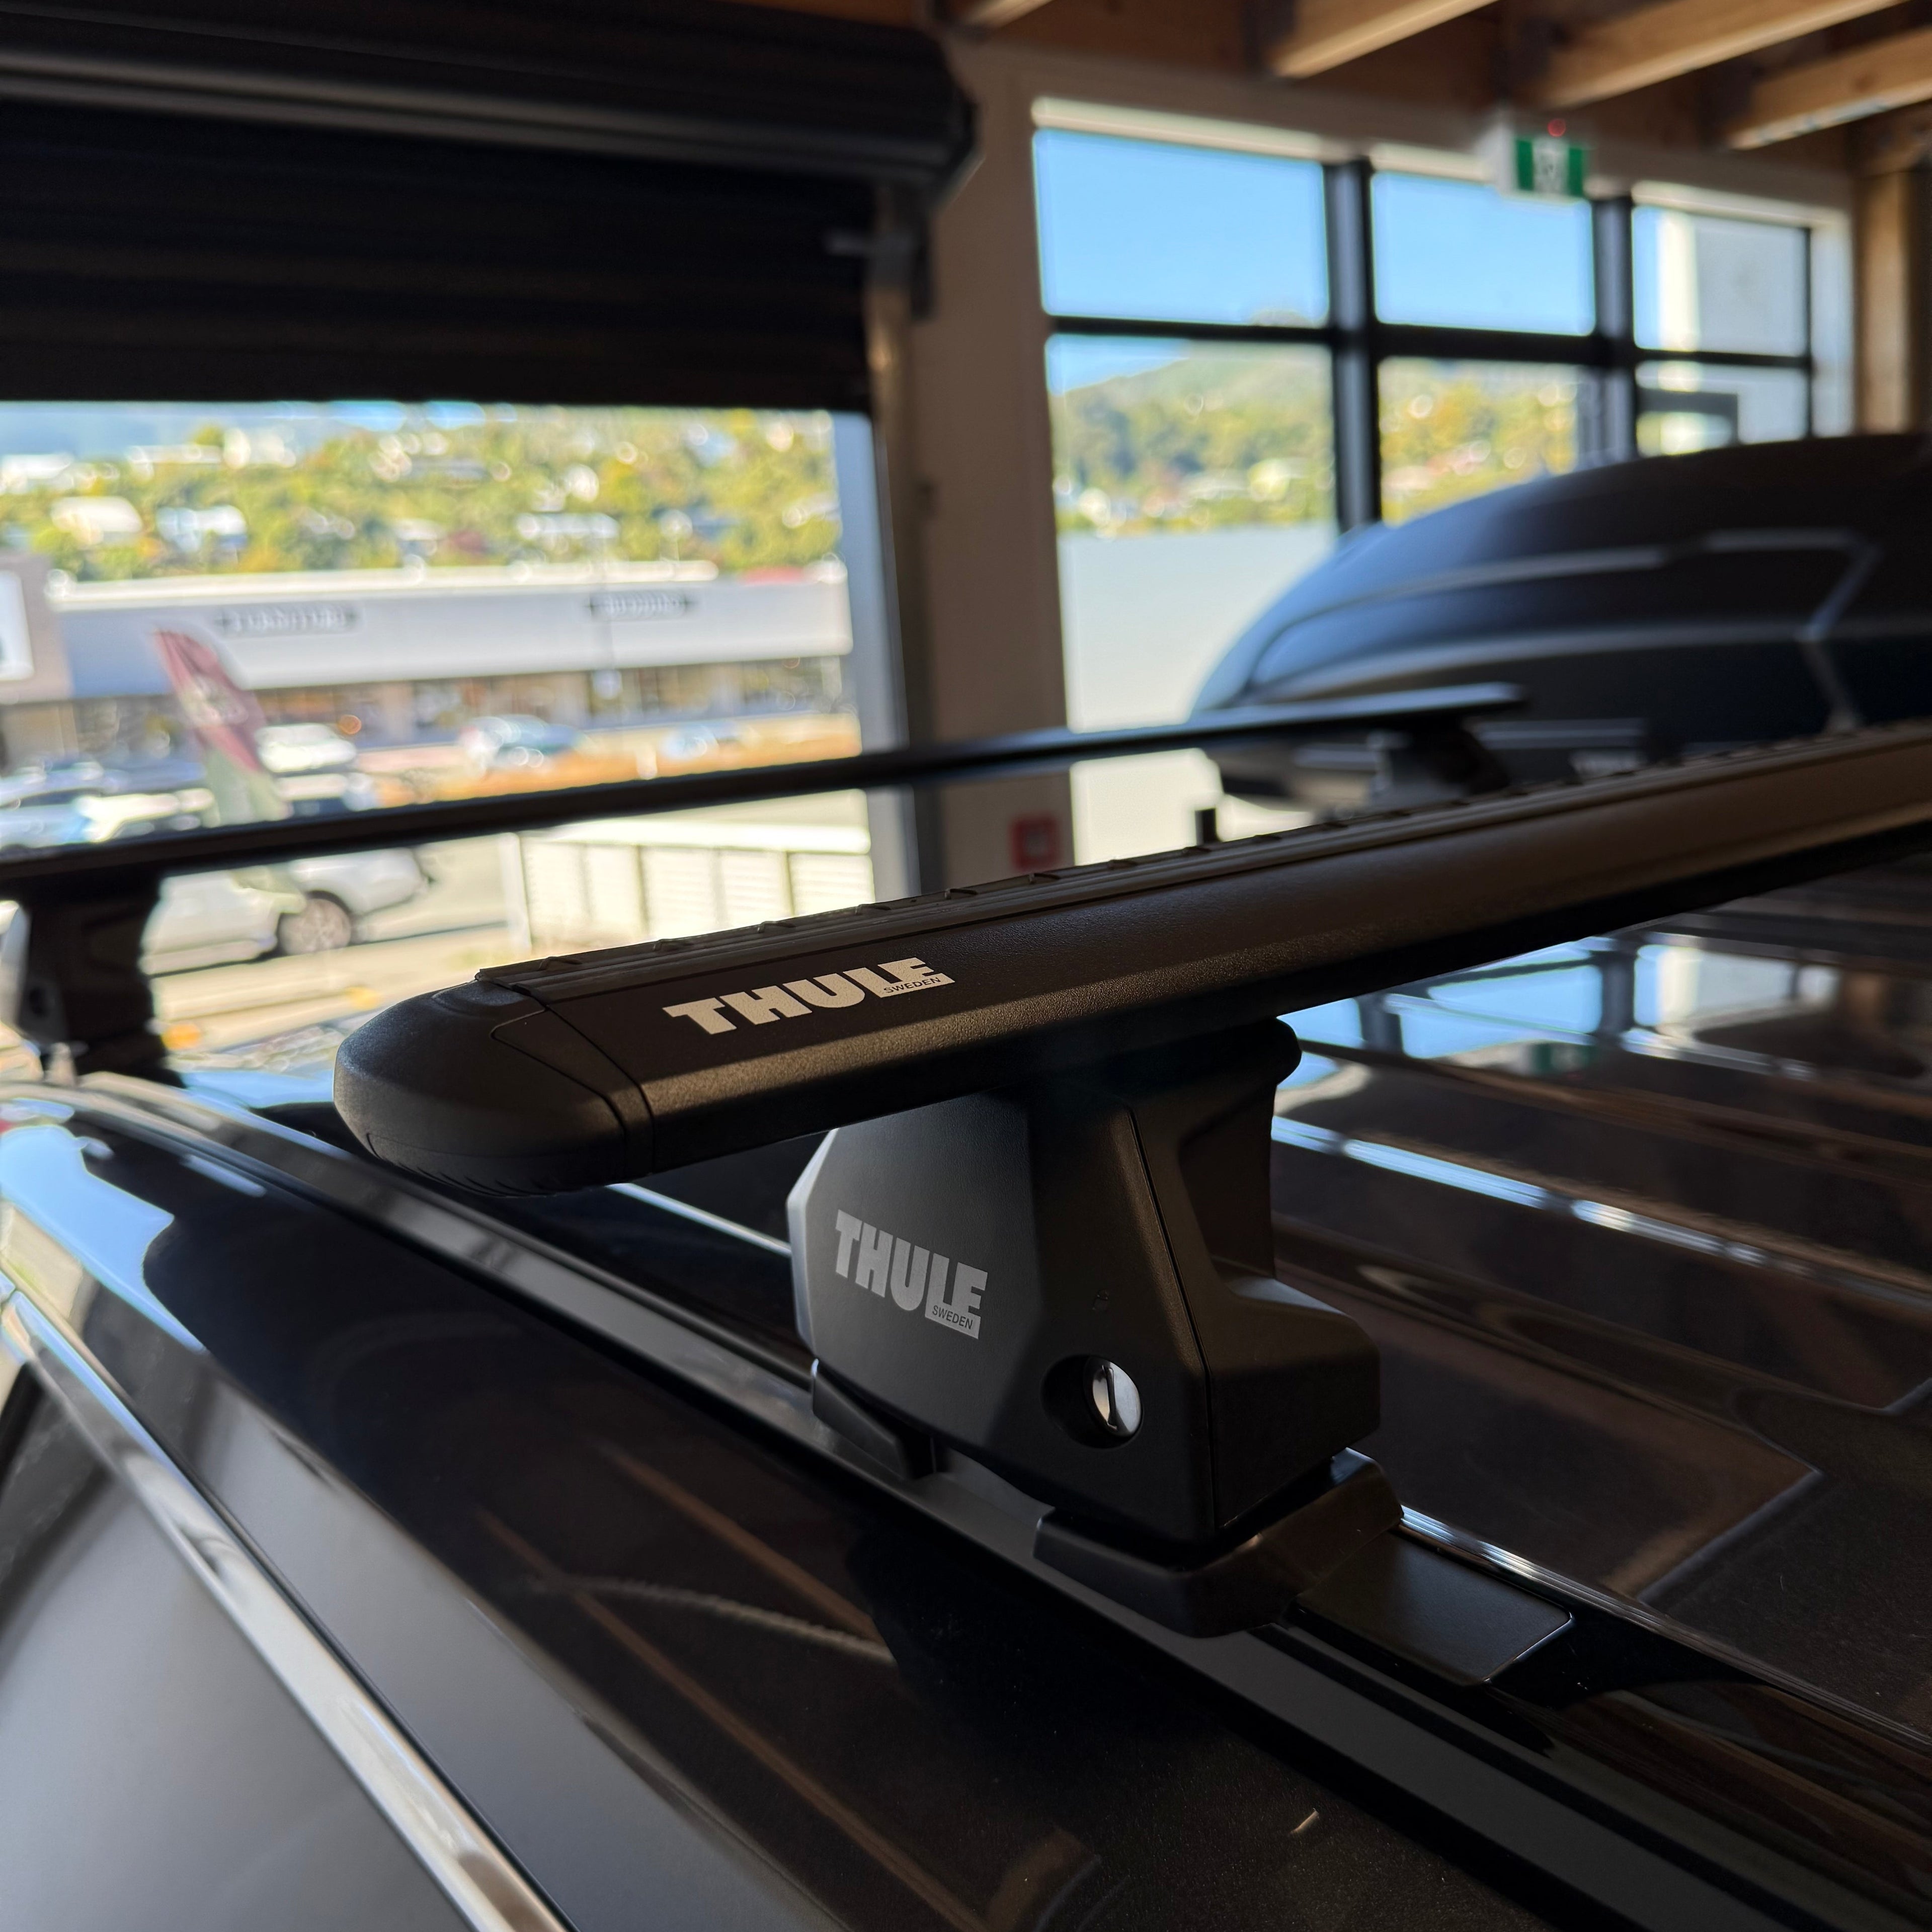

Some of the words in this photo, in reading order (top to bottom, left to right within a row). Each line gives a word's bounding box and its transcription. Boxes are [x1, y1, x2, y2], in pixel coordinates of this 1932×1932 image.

[662, 957, 955, 1034] THULE
[883, 977, 941, 993] SWEDEN
[835, 1209, 988, 1339] THULE
[932, 1305, 973, 1329] SWEDEN
